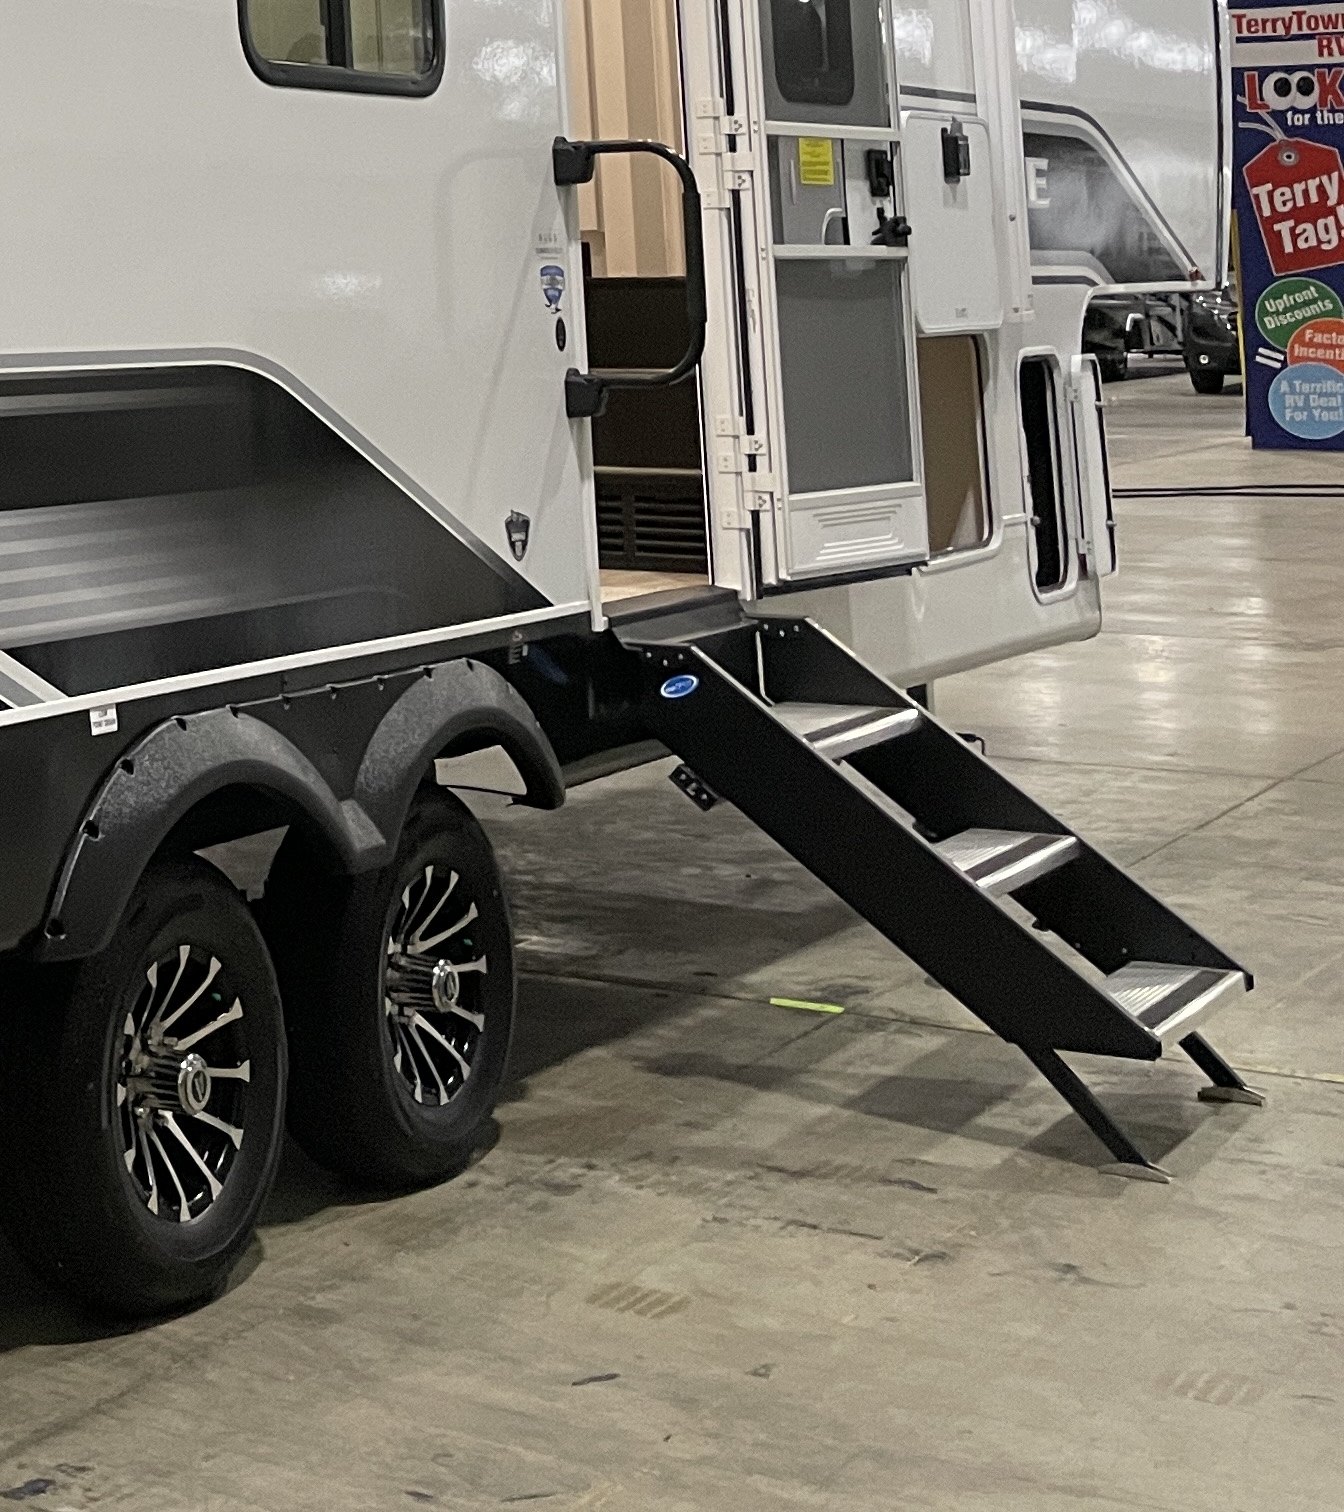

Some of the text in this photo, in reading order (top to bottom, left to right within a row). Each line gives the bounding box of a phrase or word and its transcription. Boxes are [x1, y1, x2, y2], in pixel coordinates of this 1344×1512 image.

[1232, 10, 1344, 36] TerryTow
[1287, 110, 1344, 126] for the
[1252, 171, 1339, 217] Terry
[1264, 285, 1319, 313] Upfront
[1263, 299, 1334, 330] Discounts
[1280, 380, 1291, 393] A
[1285, 394, 1342, 408] RV Deal
[1285, 408, 1308, 422] For
